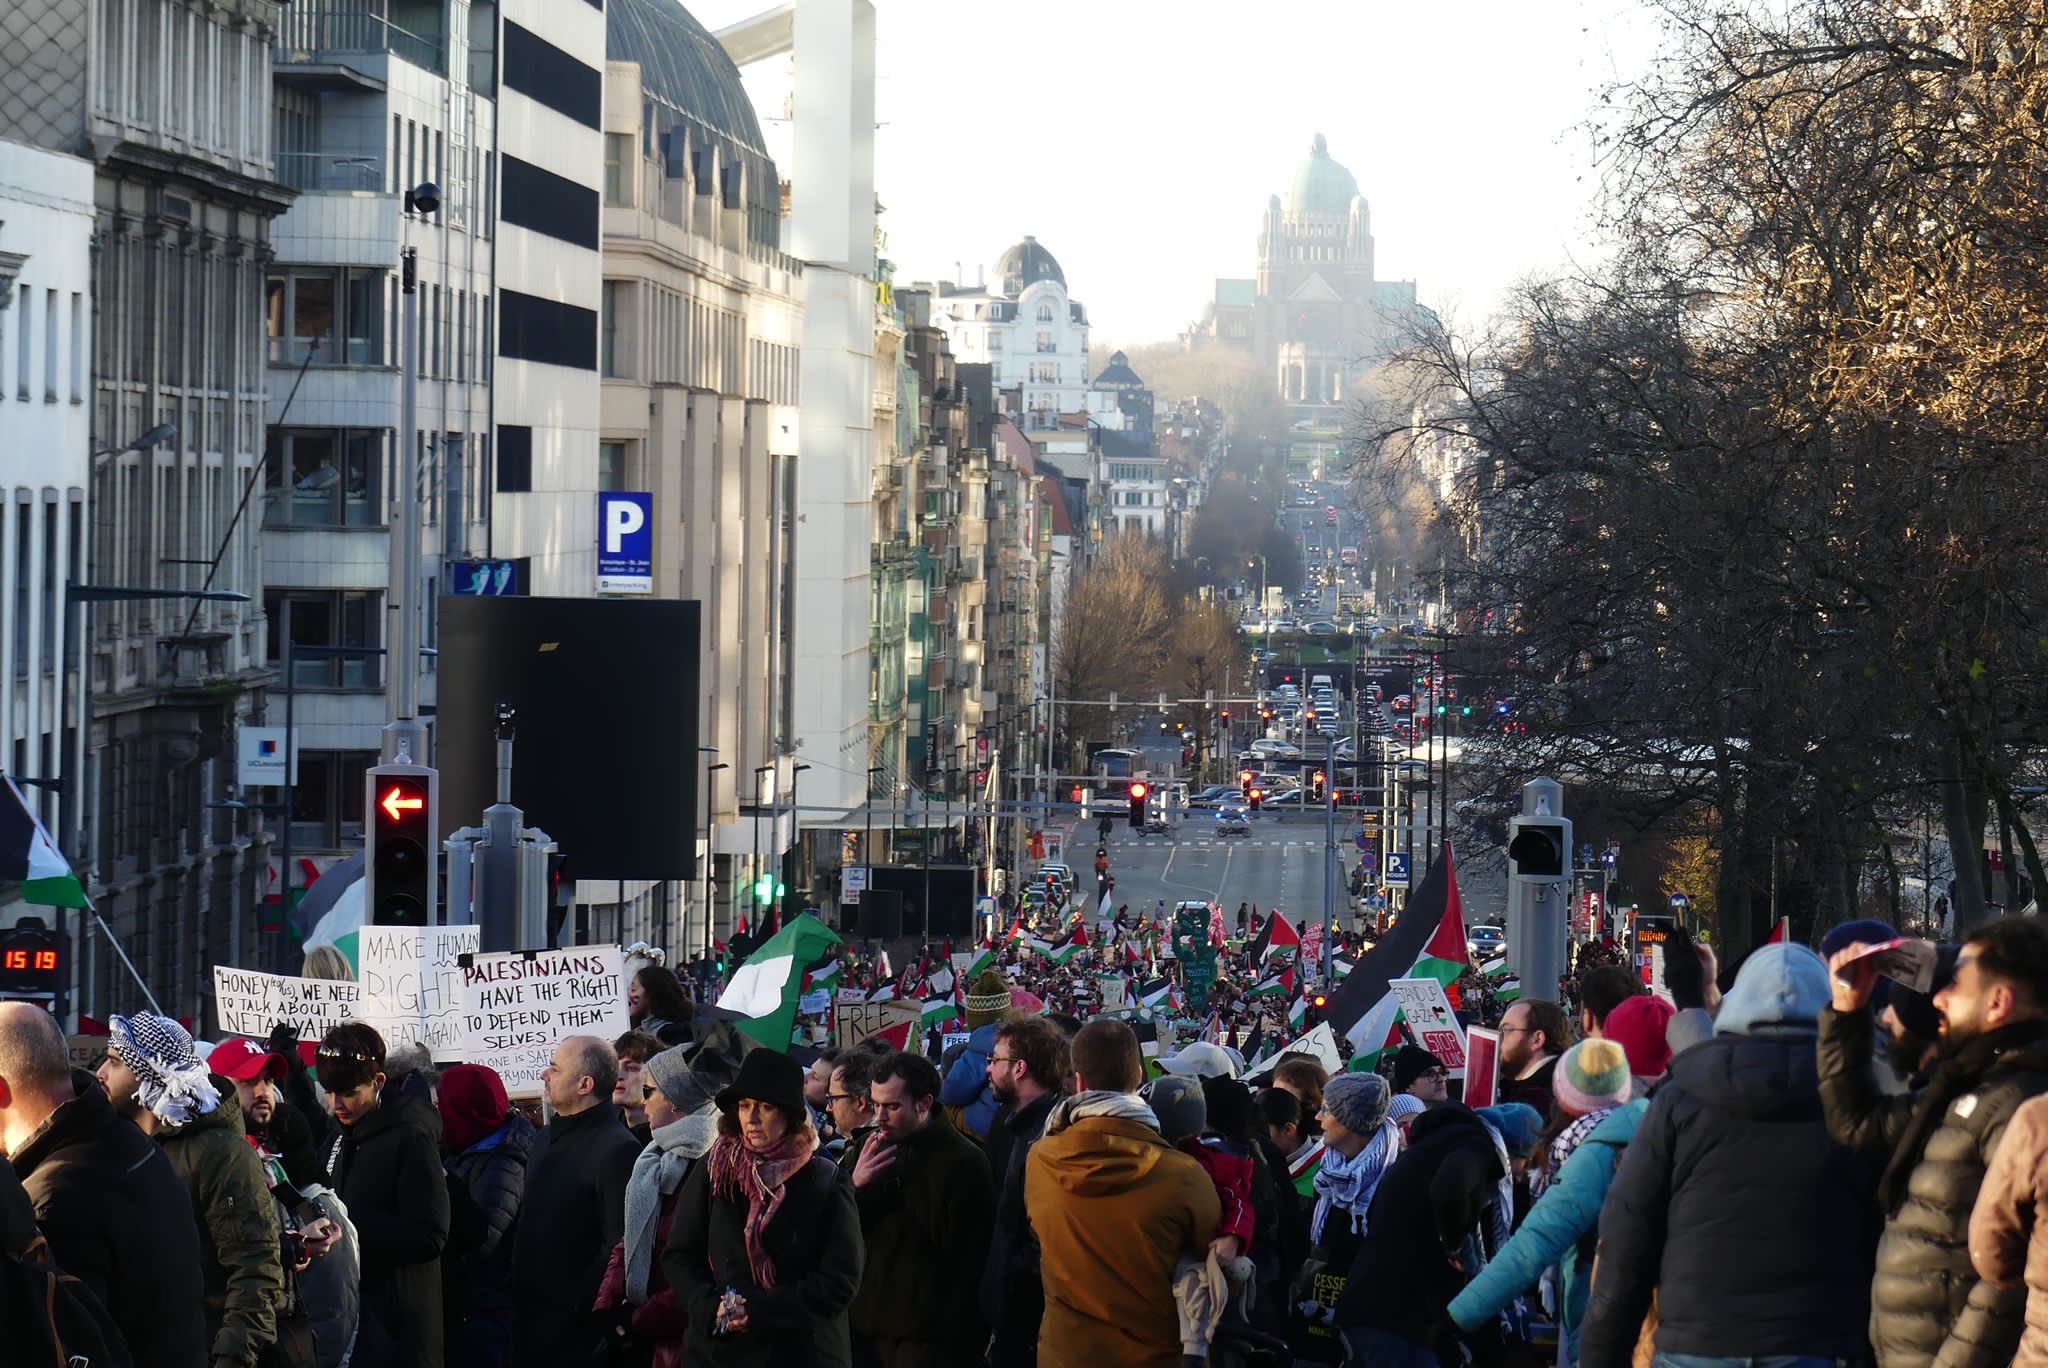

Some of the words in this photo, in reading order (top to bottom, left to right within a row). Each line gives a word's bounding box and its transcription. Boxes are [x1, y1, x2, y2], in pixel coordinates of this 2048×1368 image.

[606, 500, 644, 552] P
[1388, 855, 1401, 872] P
[5, 951, 27, 969] 15
[35, 951, 57, 969] 19
[366, 933, 426, 964] MAKE
[436, 931, 480, 962] HUMAN
[463, 955, 606, 988] PALESTINIANS
[301, 983, 322, 1001] WE
[366, 969, 460, 1013] RIGHT
[479, 984, 525, 1010] HAVE
[529, 981, 562, 1001] THE
[566, 974, 619, 1000] RIGHT
[220, 996, 234, 1009] TO
[241, 998, 271, 1015] TALK
[277, 1001, 330, 1017] ABOUT
[382, 1022, 421, 1050] REAT
[423, 1018, 463, 1048] AGAIN
[463, 1014, 482, 1033] TO
[487, 1009, 552, 1032] DEFEND
[557, 1009, 614, 1027] THEM-
[837, 1001, 895, 1049] FREE
[1425, 1031, 1457, 1052] STOP
[487, 1055, 511, 1067] ONE
[515, 1054, 525, 1063] IS
